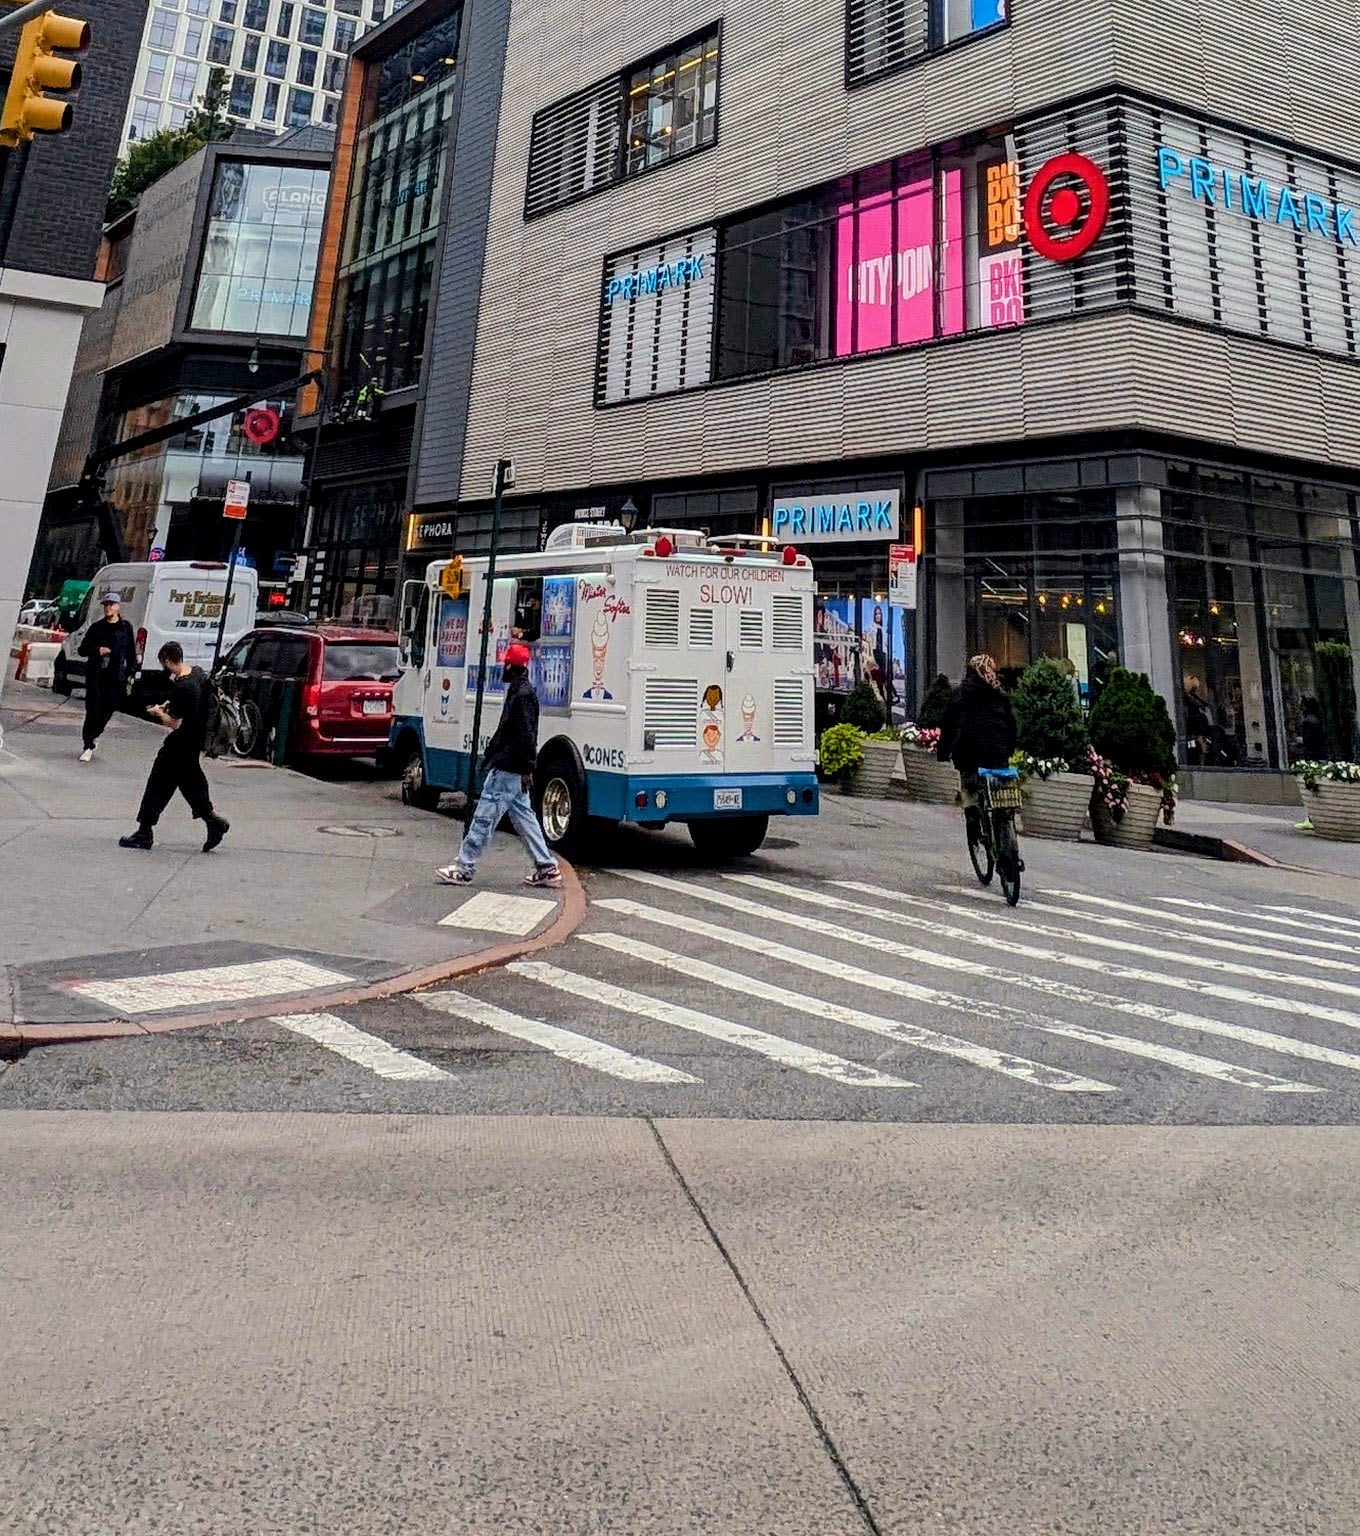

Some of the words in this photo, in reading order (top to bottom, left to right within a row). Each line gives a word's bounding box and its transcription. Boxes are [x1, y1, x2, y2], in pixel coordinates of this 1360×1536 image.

[1156, 145, 1358, 246] PRIMARK
[606, 254, 705, 304] PRIMARK
[848, 242, 948, 306] CITYOIN
[238, 287, 312, 307] PRMAR
[774, 500, 893, 535] PRIMARK
[414, 522, 453, 538] SEPHORA
[666, 564, 698, 578] WATCH
[700, 565, 718, 578] FOR
[720, 567, 740, 581] OUR
[741, 568, 785, 582] CHILDREN
[700, 584, 752, 605] SLOW!
[589, 744, 625, 768] CONES
